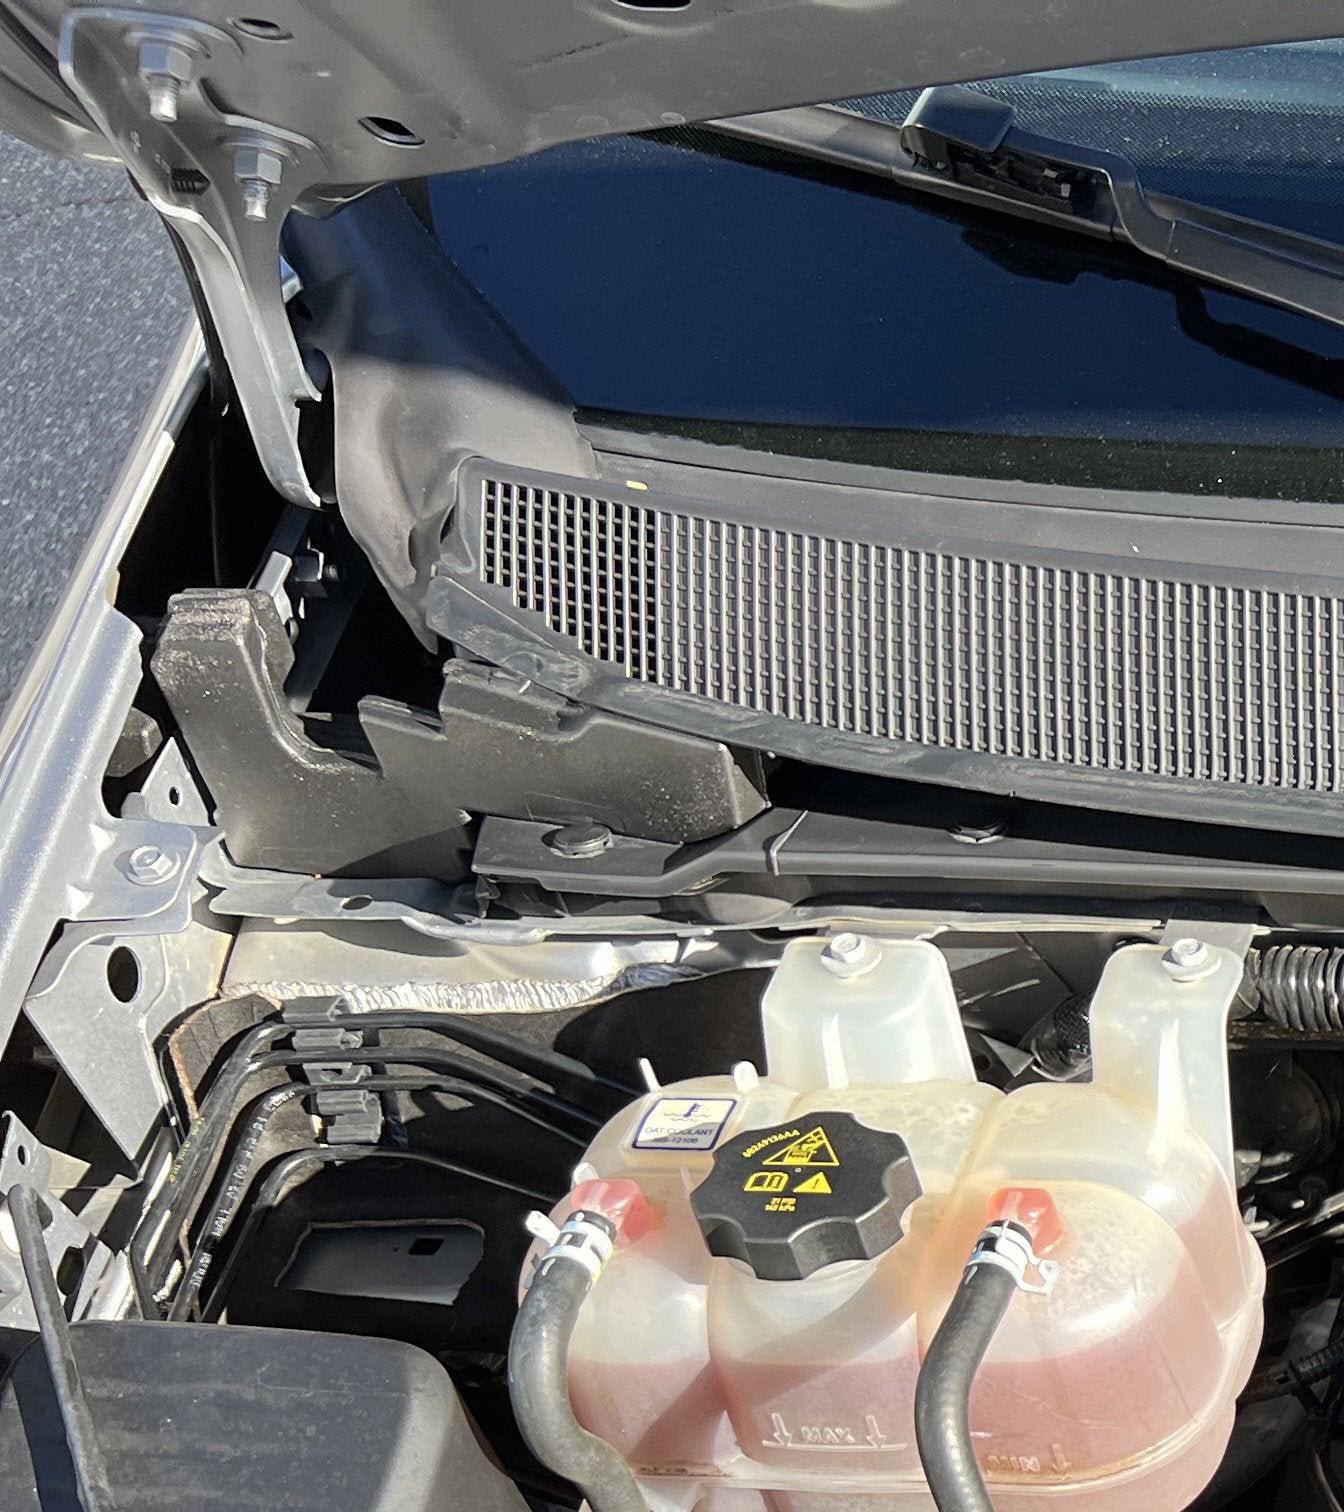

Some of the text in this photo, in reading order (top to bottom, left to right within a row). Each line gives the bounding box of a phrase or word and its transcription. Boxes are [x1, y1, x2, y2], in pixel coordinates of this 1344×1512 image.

[666, 1127, 715, 1136] COOLANT
[801, 1426, 856, 1444] MAX
[985, 1454, 1041, 1473] MIN
